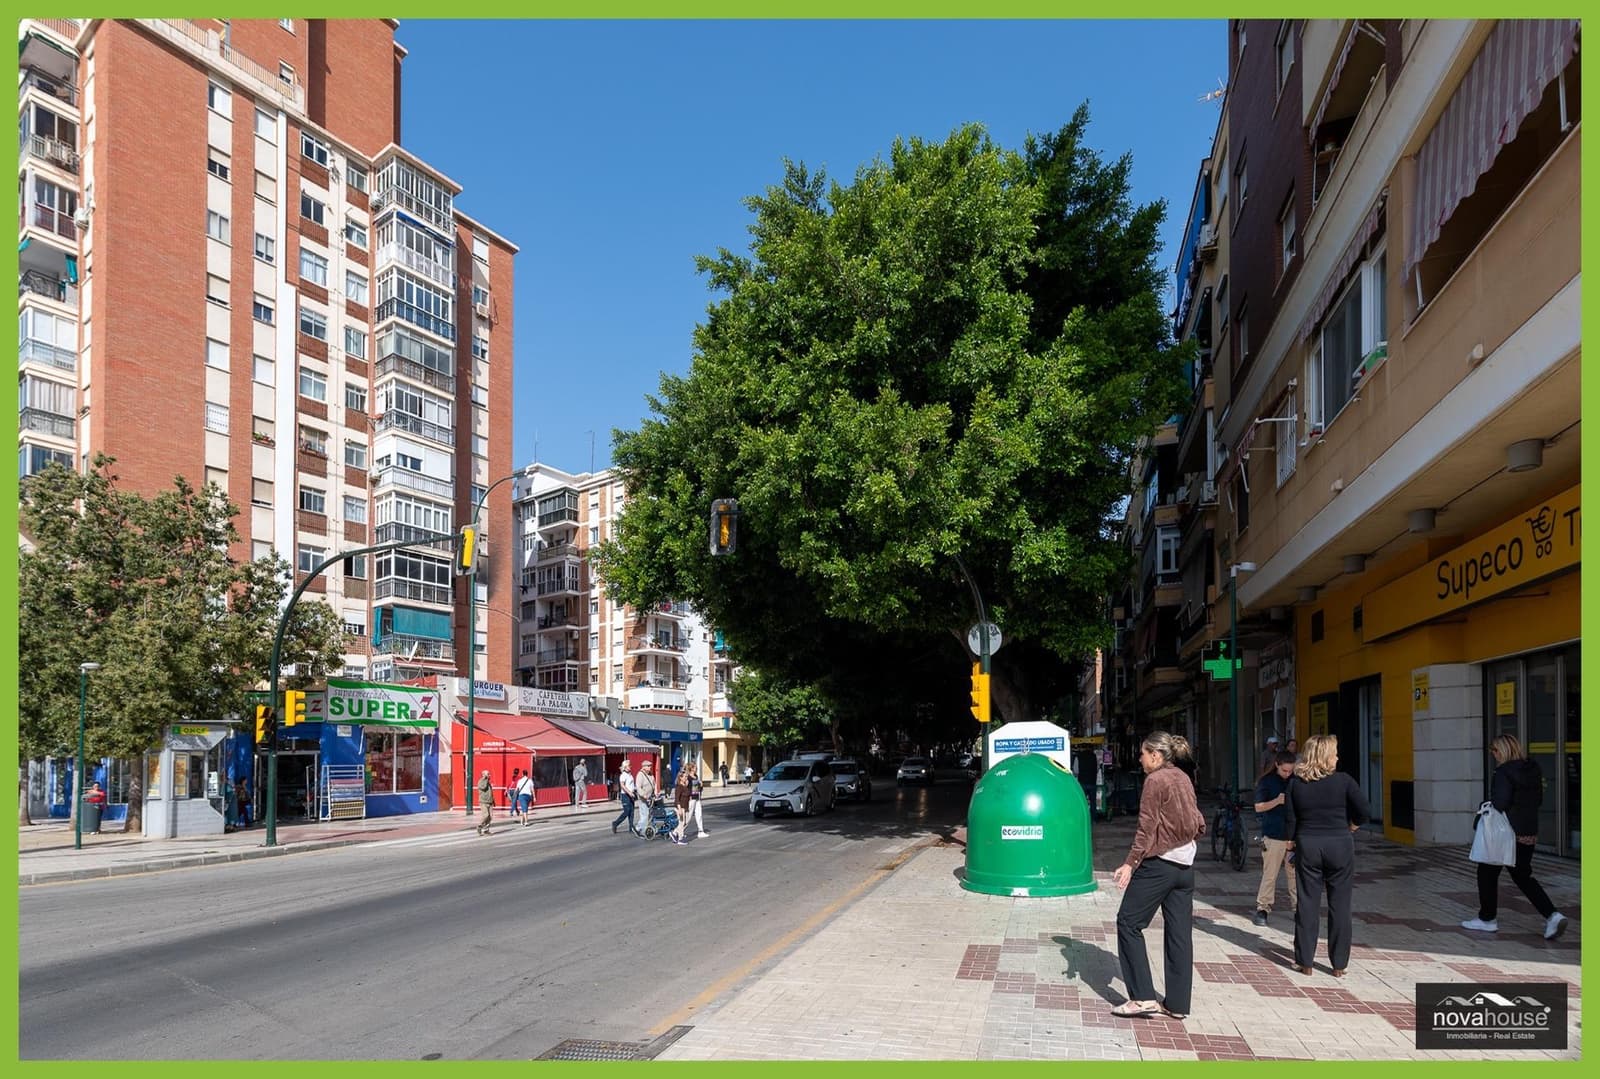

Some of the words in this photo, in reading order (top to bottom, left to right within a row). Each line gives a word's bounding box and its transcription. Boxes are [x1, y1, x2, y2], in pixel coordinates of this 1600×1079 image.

[1437, 537, 1523, 599] Supeco
[1563, 506, 1581, 546] T
[474, 681, 504, 692] URGUER
[329, 696, 410, 719] SUPER
[537, 698, 546, 706] LA
[549, 700, 573, 709] PALOMA
[1002, 827, 1042, 836] ecovidrio
